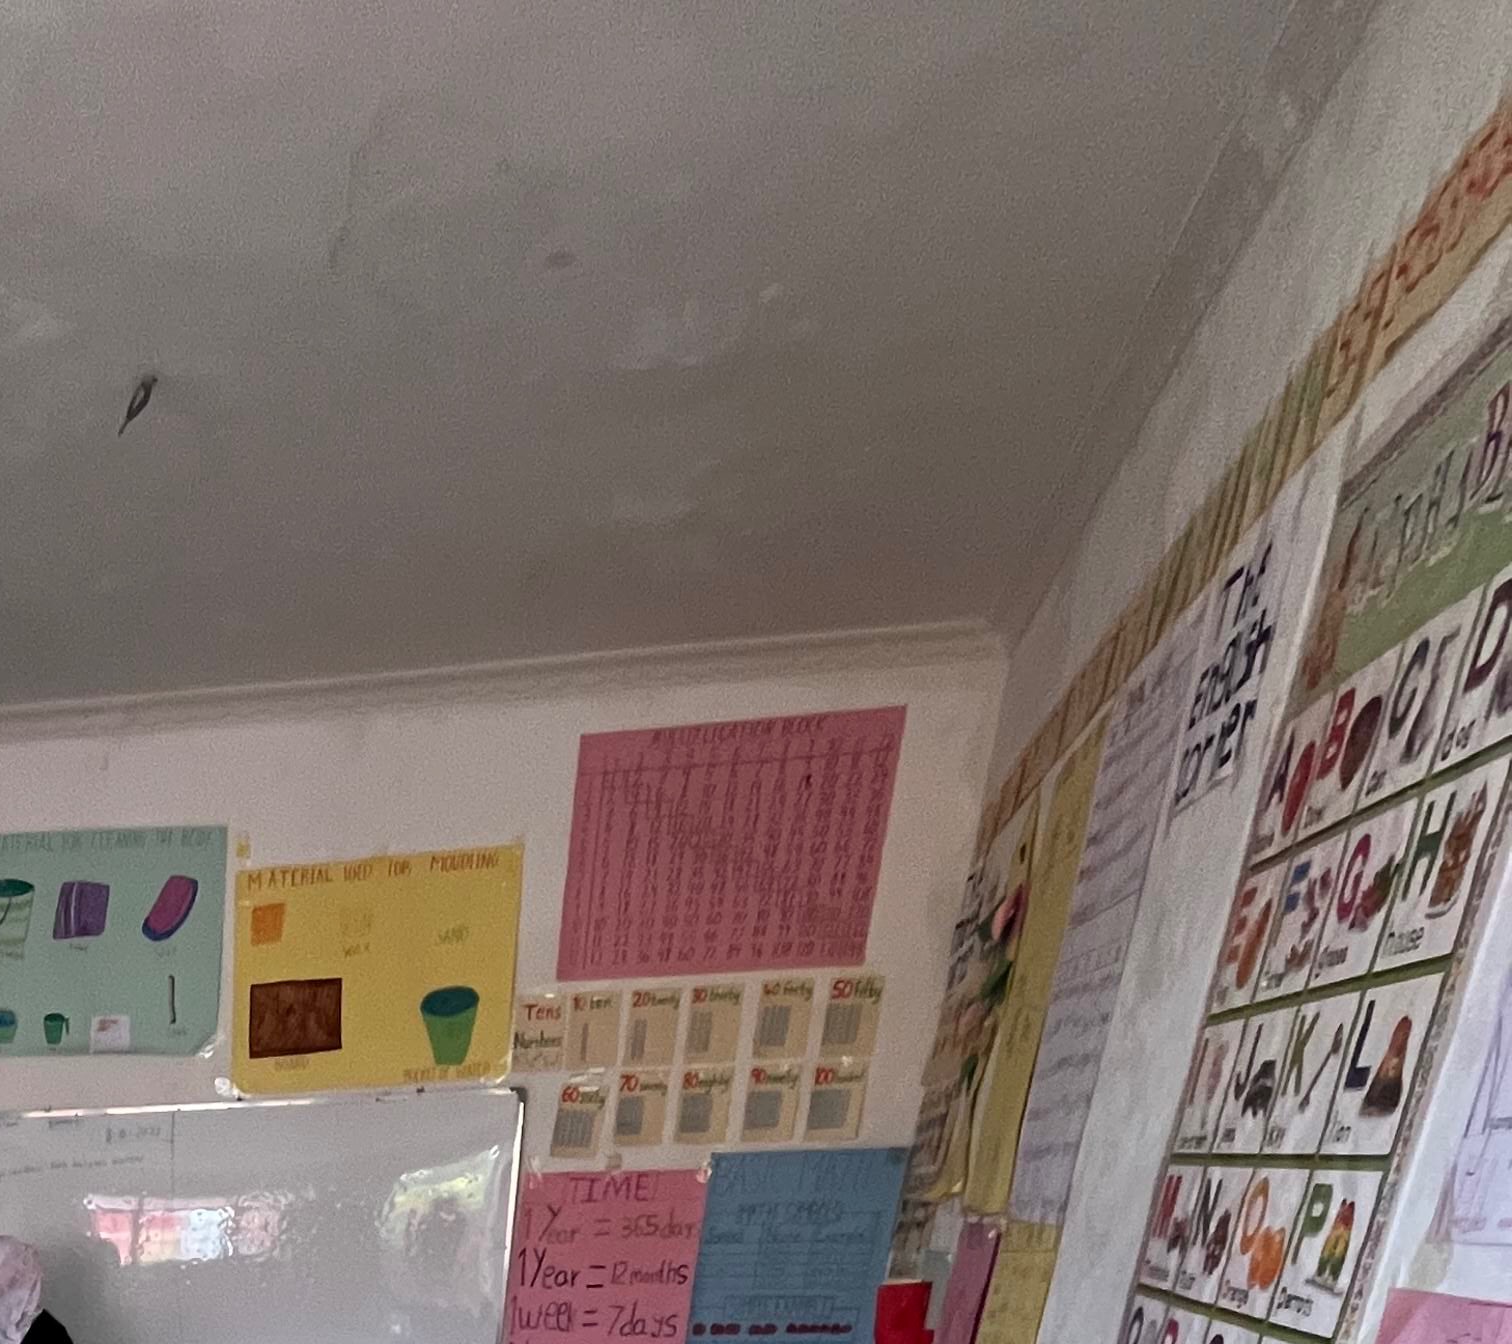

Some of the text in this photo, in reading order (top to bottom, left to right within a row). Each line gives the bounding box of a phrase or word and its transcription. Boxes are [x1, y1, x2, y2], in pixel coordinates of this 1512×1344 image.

[1316, 688, 1355, 781] B
[1400, 790, 1458, 901] H
[246, 866, 334, 893] MATERIAL
[632, 991, 650, 1009] 20
[831, 979, 854, 1000] 50
[522, 1002, 563, 1022] Tens
[1282, 1011, 1320, 1096] K
[1343, 999, 1377, 1090] L
[619, 1073, 639, 1093] 70
[750, 1067, 767, 1084] 90
[561, 1085, 580, 1103] 60
[569, 1172, 651, 1204] TIME
[1240, 1175, 1271, 1256] O
[1291, 1182, 1334, 1265] P
